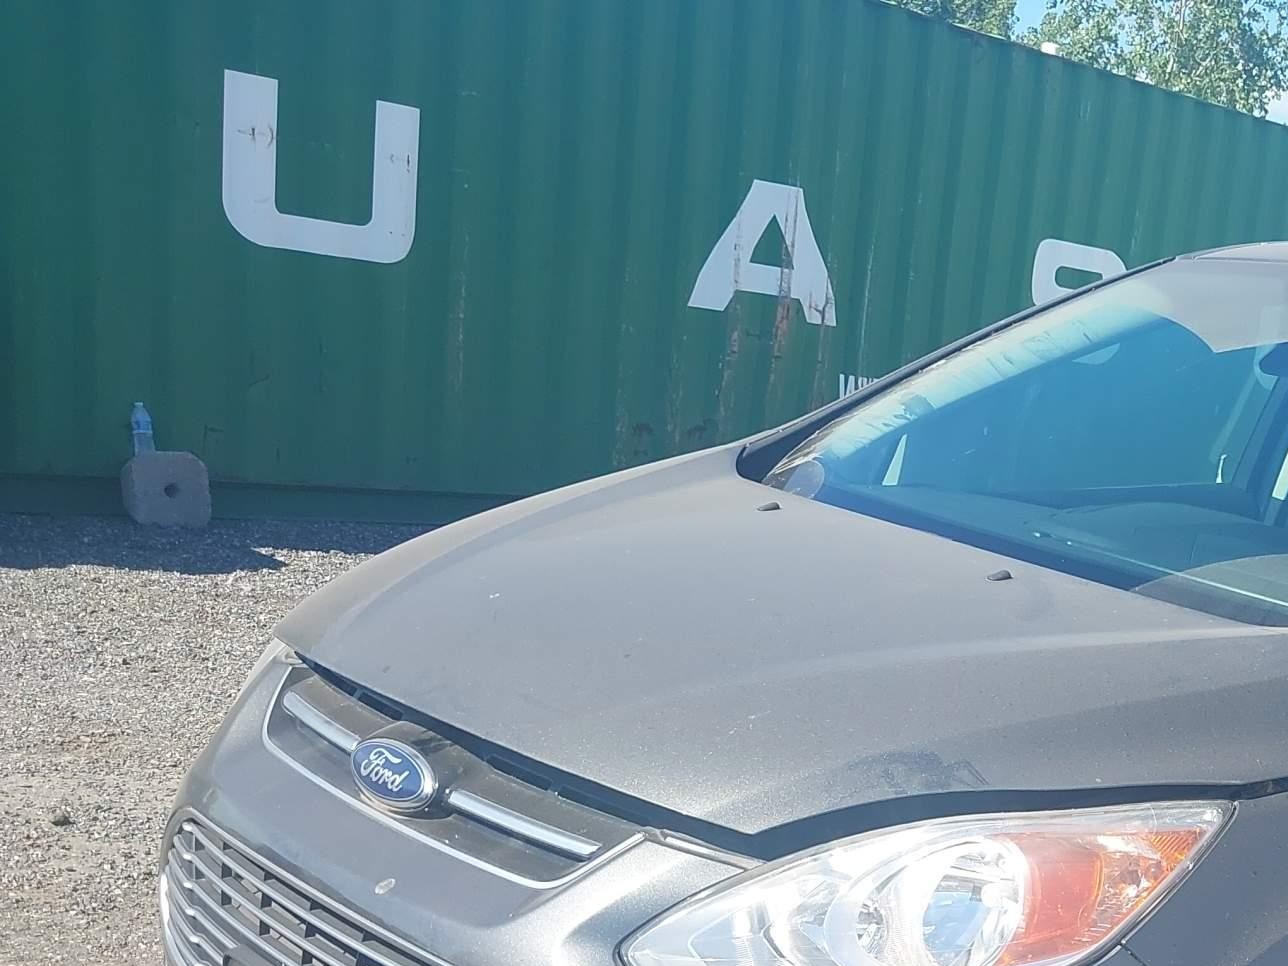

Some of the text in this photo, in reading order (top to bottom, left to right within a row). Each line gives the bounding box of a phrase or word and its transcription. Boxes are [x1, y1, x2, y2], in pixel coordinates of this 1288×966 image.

[222, 69, 420, 264] U
[687, 179, 838, 327] A
[360, 747, 410, 793] Ford
